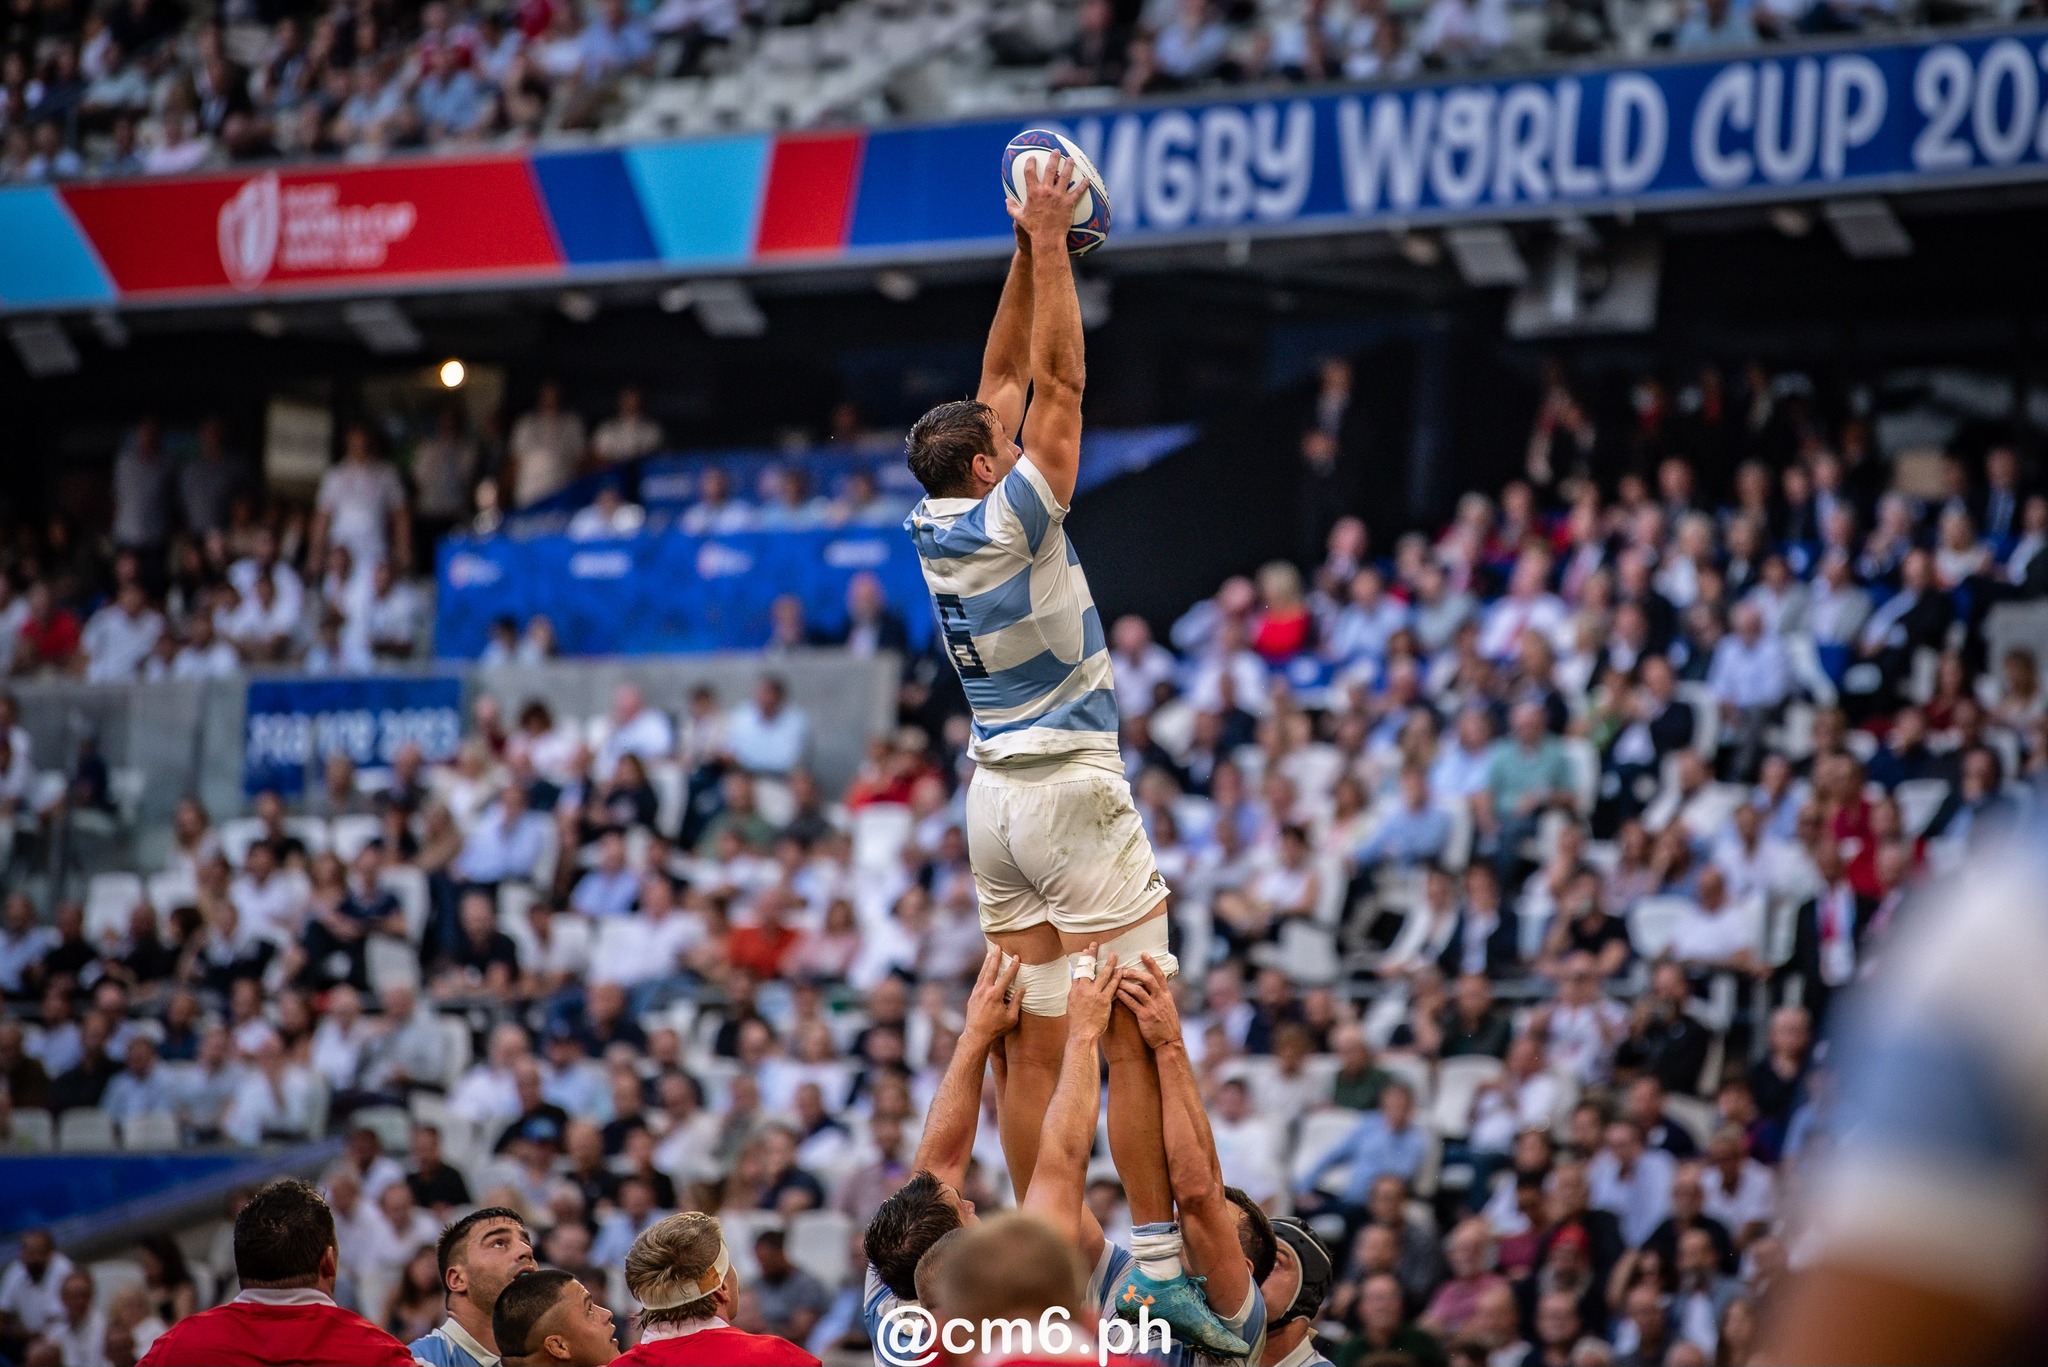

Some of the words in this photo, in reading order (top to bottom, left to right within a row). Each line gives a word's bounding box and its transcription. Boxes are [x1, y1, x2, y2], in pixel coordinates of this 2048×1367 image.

[1030, 100, 1315, 234] UGBY
[1336, 72, 1669, 214] WORLD
[1691, 61, 1887, 187] CUP
[1911, 40, 2048, 170] 20
[935, 593, 990, 679] 6
